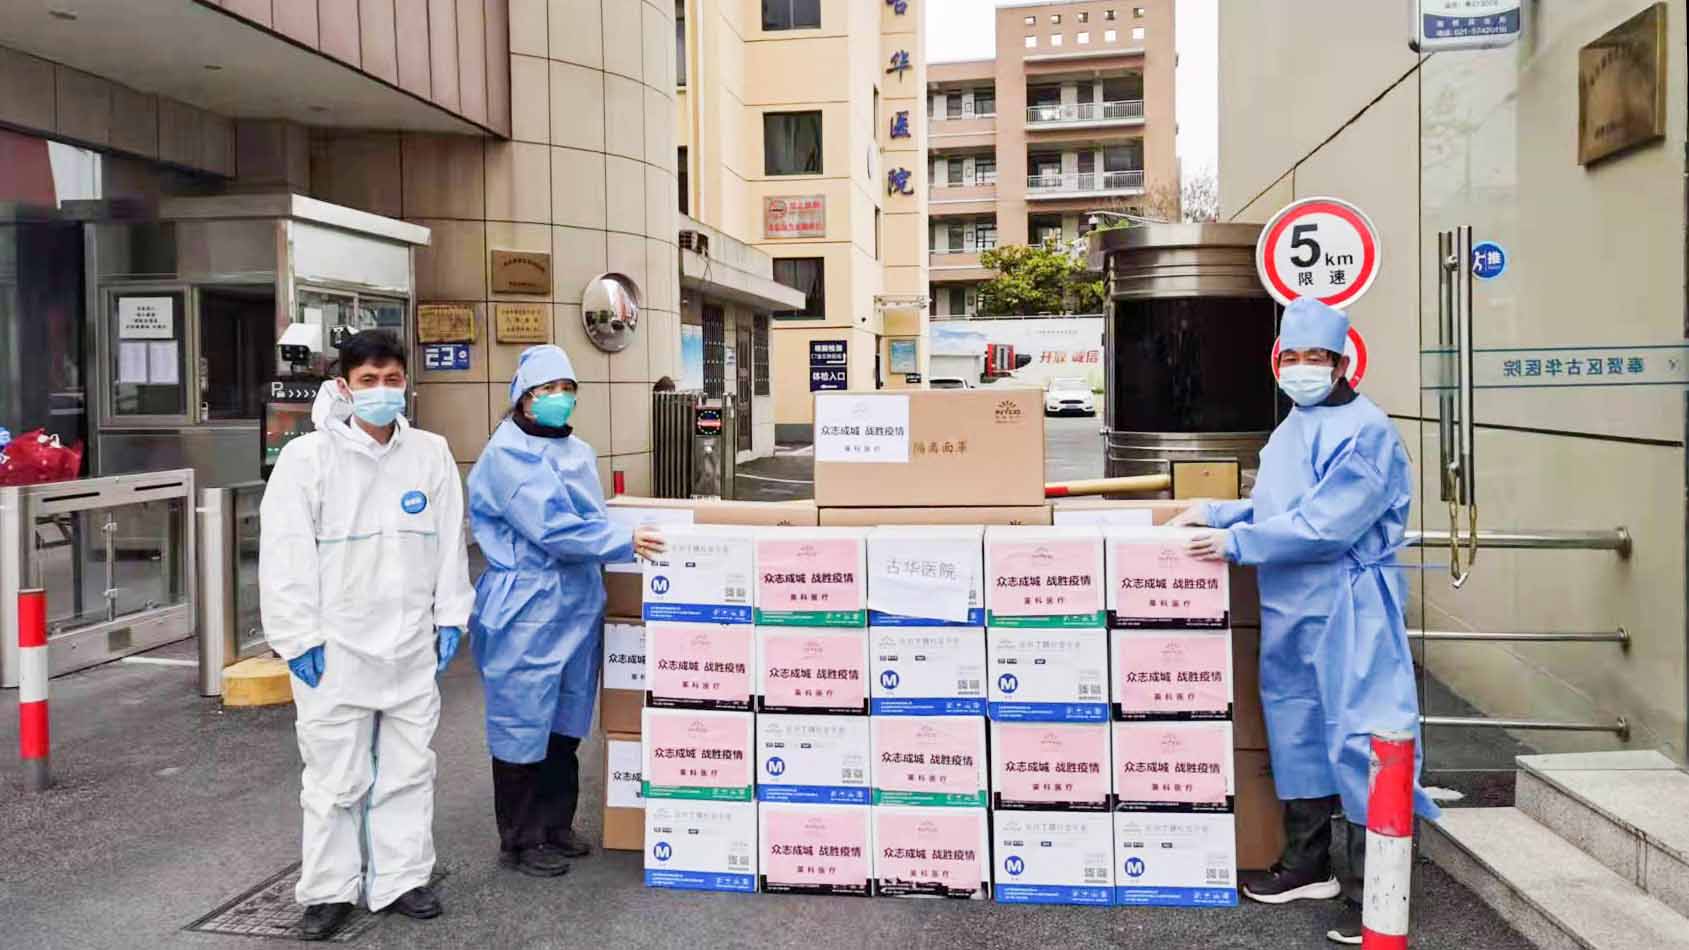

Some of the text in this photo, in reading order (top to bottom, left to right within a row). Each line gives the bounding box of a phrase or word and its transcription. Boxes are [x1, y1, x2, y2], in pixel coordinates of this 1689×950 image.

[1289, 223, 1354, 268] 5 km
[1298, 269, 1347, 287] 限速
[821, 425, 905, 436] 众志成城 战胜疫情
[887, 557, 957, 581] 古华医院
[652, 578, 668, 591] M
[764, 572, 854, 584] 众志成城 战胜疫情
[996, 575, 1091, 587] 众志成城 战胜疫情
[1121, 577, 1219, 590] 众志成城 战胜疫情
[658, 658, 746, 674] 众志成城 战胜疫情
[769, 667, 859, 681] 众志成城 战胜疫情
[882, 674, 897, 687] M
[1126, 671, 1222, 683] 众志成城 战胜疫情
[1000, 677, 1015, 690] M
[655, 747, 743, 761] 众志成城 战胜疫情
[881, 751, 973, 767] 众志成城 战胜疫情
[768, 760, 783, 773] M
[1005, 760, 1100, 774] 众志成城 战胜疫情
[1124, 761, 1220, 774] 众志成城 战胜疫情
[655, 845, 670, 858] M
[771, 844, 861, 857] 众志成城 战胜疫情
[884, 847, 976, 861] 众志成城 战胜疫情
[1006, 859, 1022, 872] M
[1126, 861, 1142, 874] M
